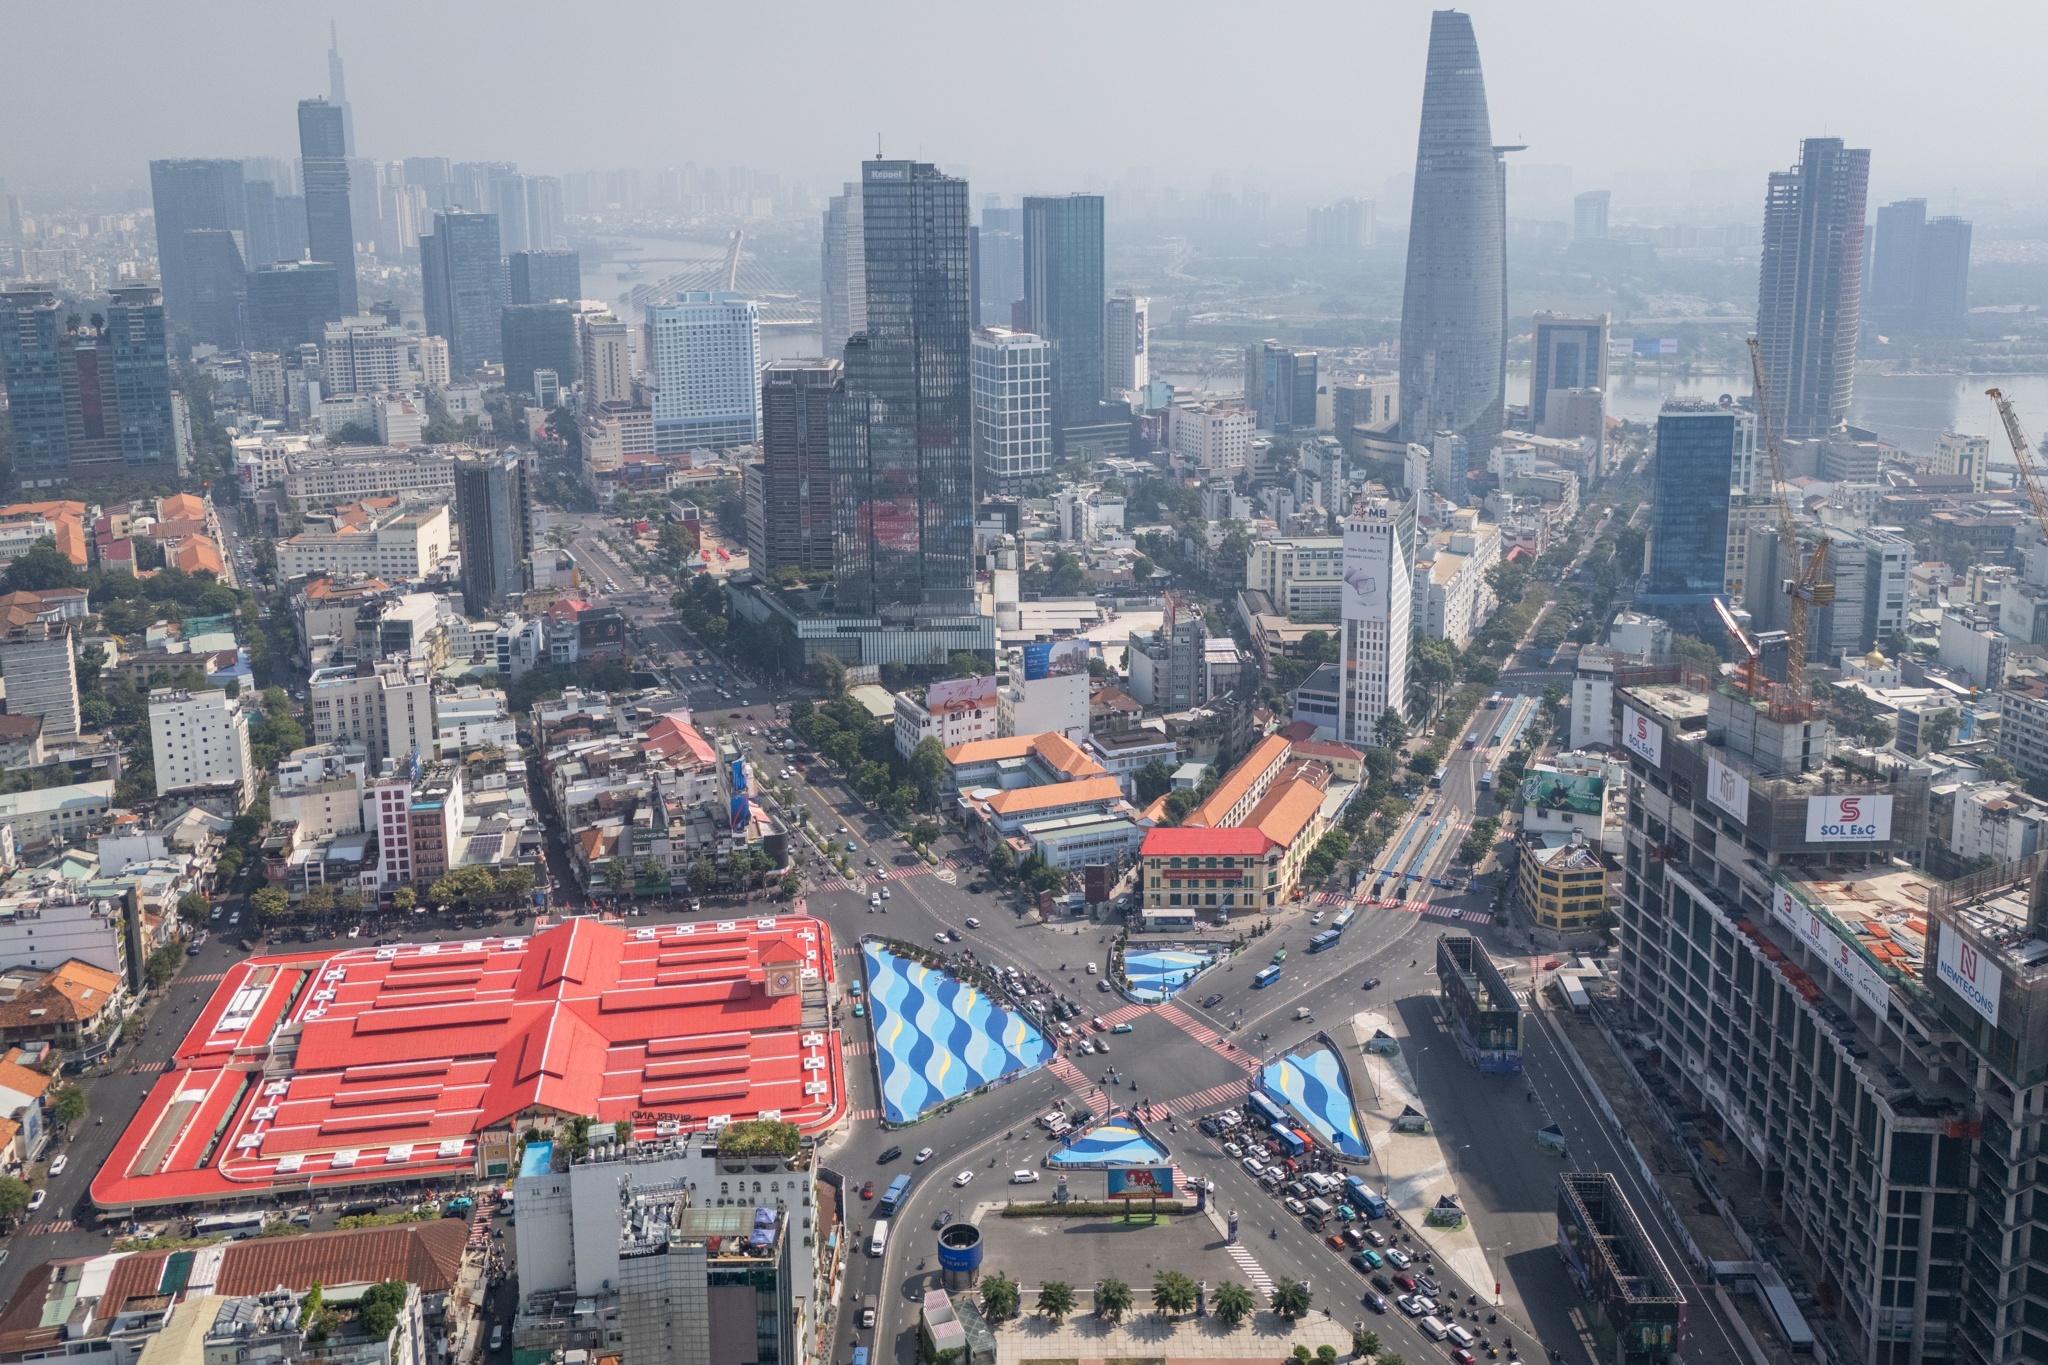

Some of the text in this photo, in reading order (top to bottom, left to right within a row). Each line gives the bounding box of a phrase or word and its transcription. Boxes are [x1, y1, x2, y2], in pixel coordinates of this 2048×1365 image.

[871, 170, 901, 179] Keppel
[1368, 508, 1387, 518] MB
[1628, 733, 1641, 749] SOL
[1524, 777, 1541, 799] TUBORG
[1820, 824, 1876, 836] SOL E&C
[1800, 927, 1828, 957] NEWTECONS
[1833, 957, 1844, 971] SOL
[1858, 980, 1887, 1010] ARTELIA
[1940, 960, 1994, 1014] NEWTECONS
